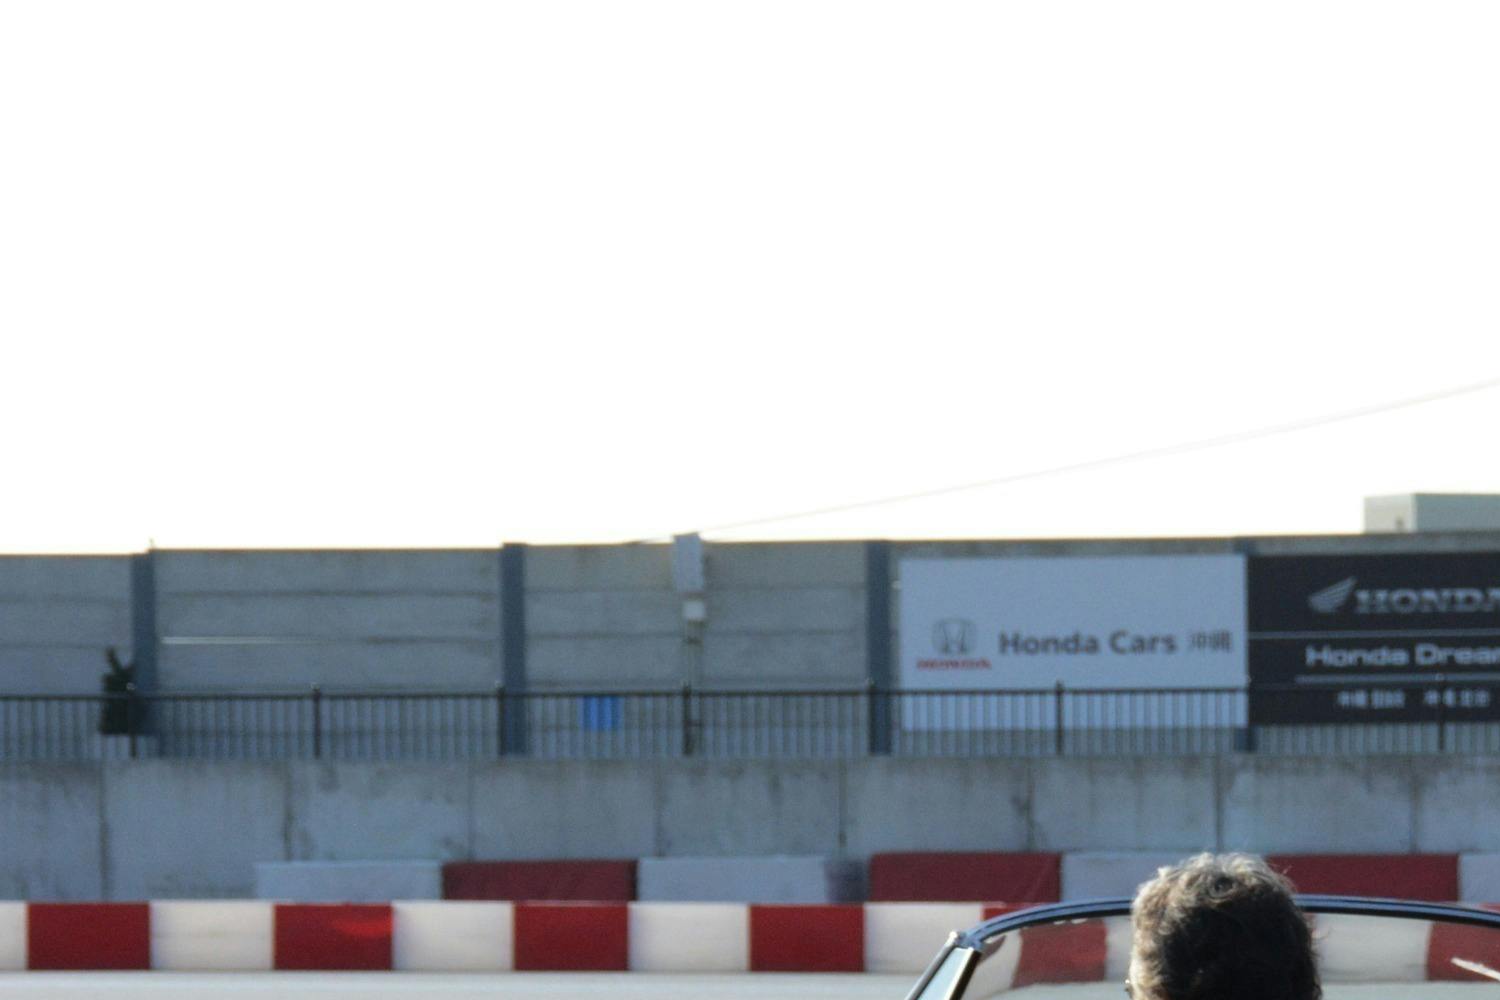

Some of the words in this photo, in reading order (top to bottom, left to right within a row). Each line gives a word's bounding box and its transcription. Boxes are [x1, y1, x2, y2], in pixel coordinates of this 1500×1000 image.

[998, 630, 1099, 656] Honda
[1109, 629, 1177, 655] Cars
[1305, 644, 1409, 668] Honda
